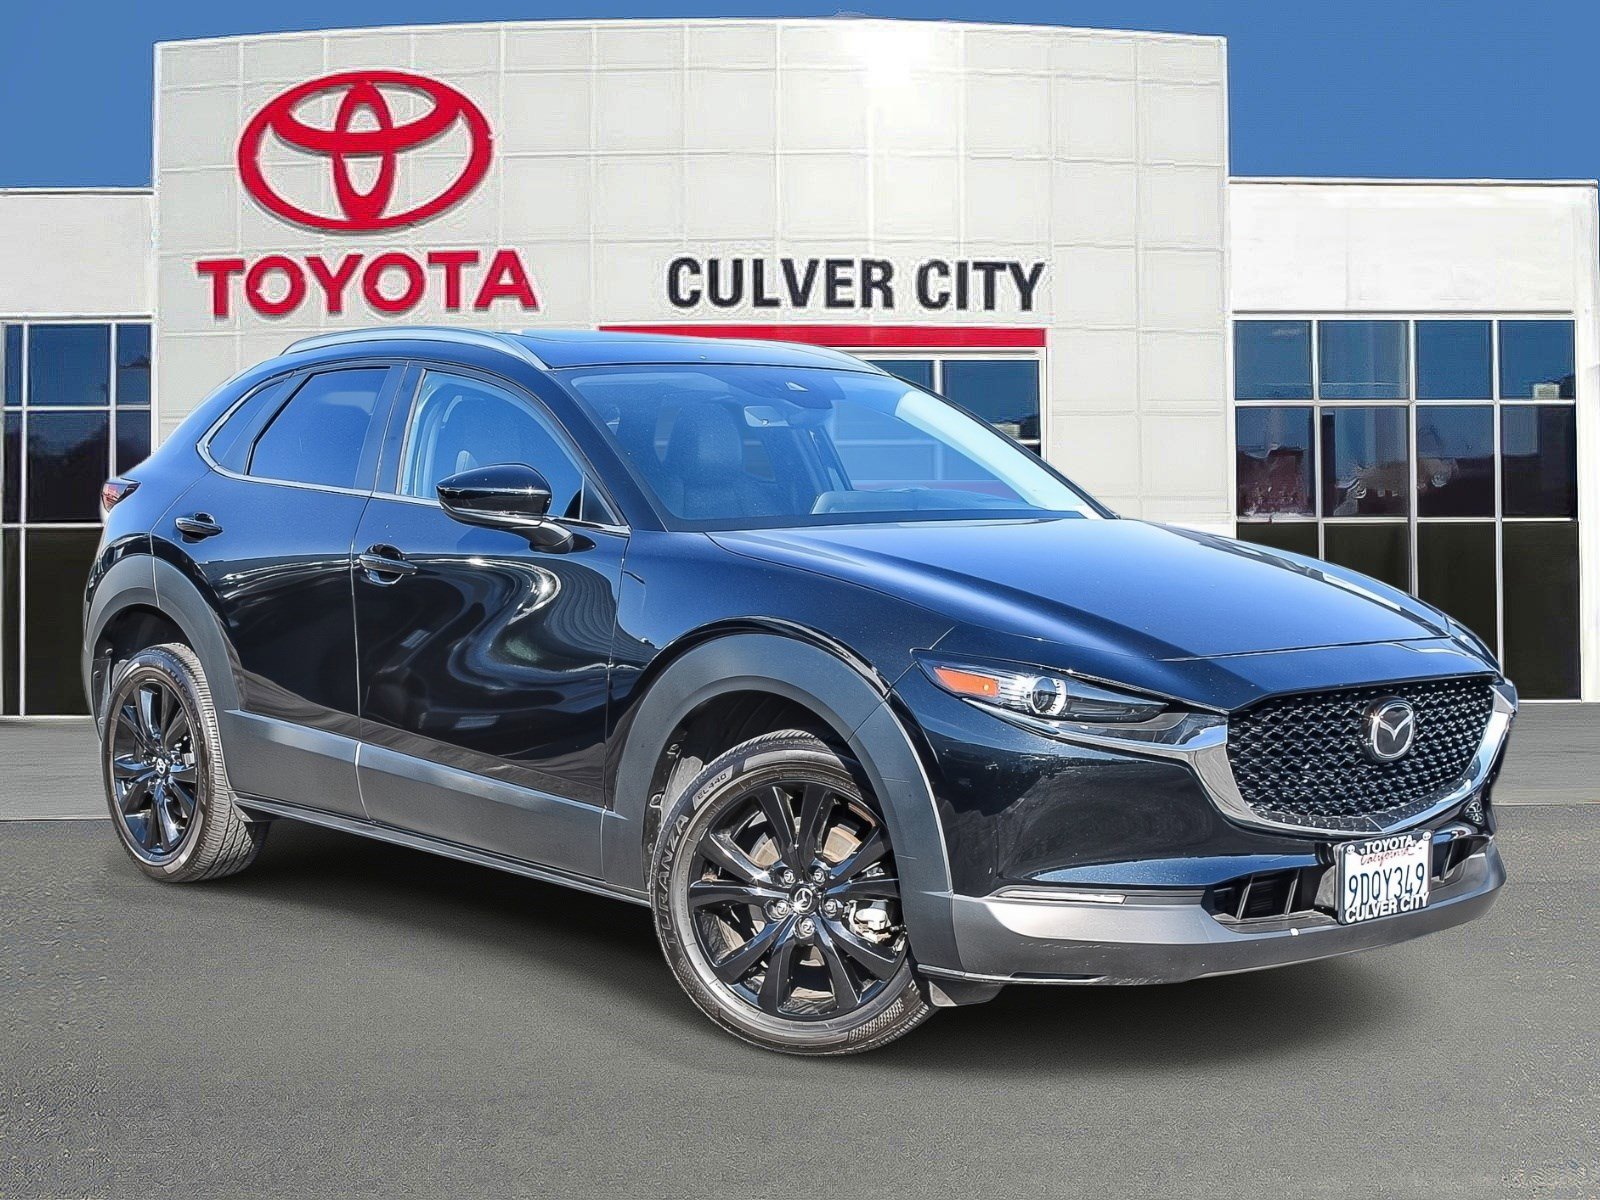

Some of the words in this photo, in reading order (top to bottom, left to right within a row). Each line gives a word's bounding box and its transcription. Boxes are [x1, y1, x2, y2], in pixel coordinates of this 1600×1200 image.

[196, 249, 539, 318] TOYOTA
[667, 257, 895, 309] CULVER
[916, 259, 1046, 312] CITY
[1364, 835, 1414, 855] TOYOTA
[658, 814, 690, 950] TURANZA
[1345, 898, 1398, 924] CULVER
[1400, 891, 1430, 913] CITY
